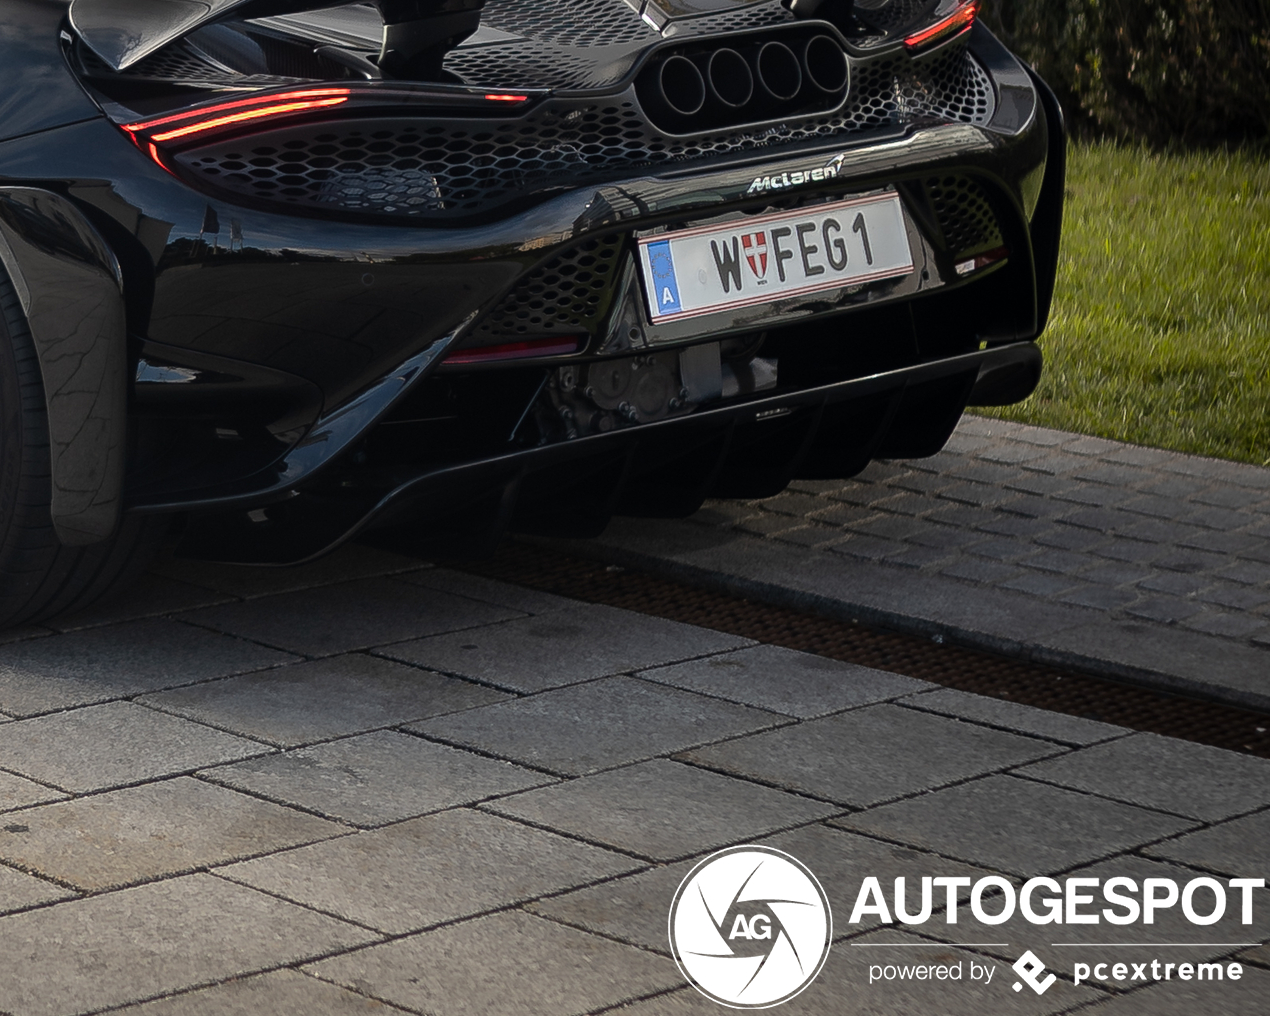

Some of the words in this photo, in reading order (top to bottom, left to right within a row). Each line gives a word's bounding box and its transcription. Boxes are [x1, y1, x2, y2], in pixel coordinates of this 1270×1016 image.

[746, 166, 838, 194] McLaren
[710, 236, 742, 294] W
[662, 286, 675, 305] A
